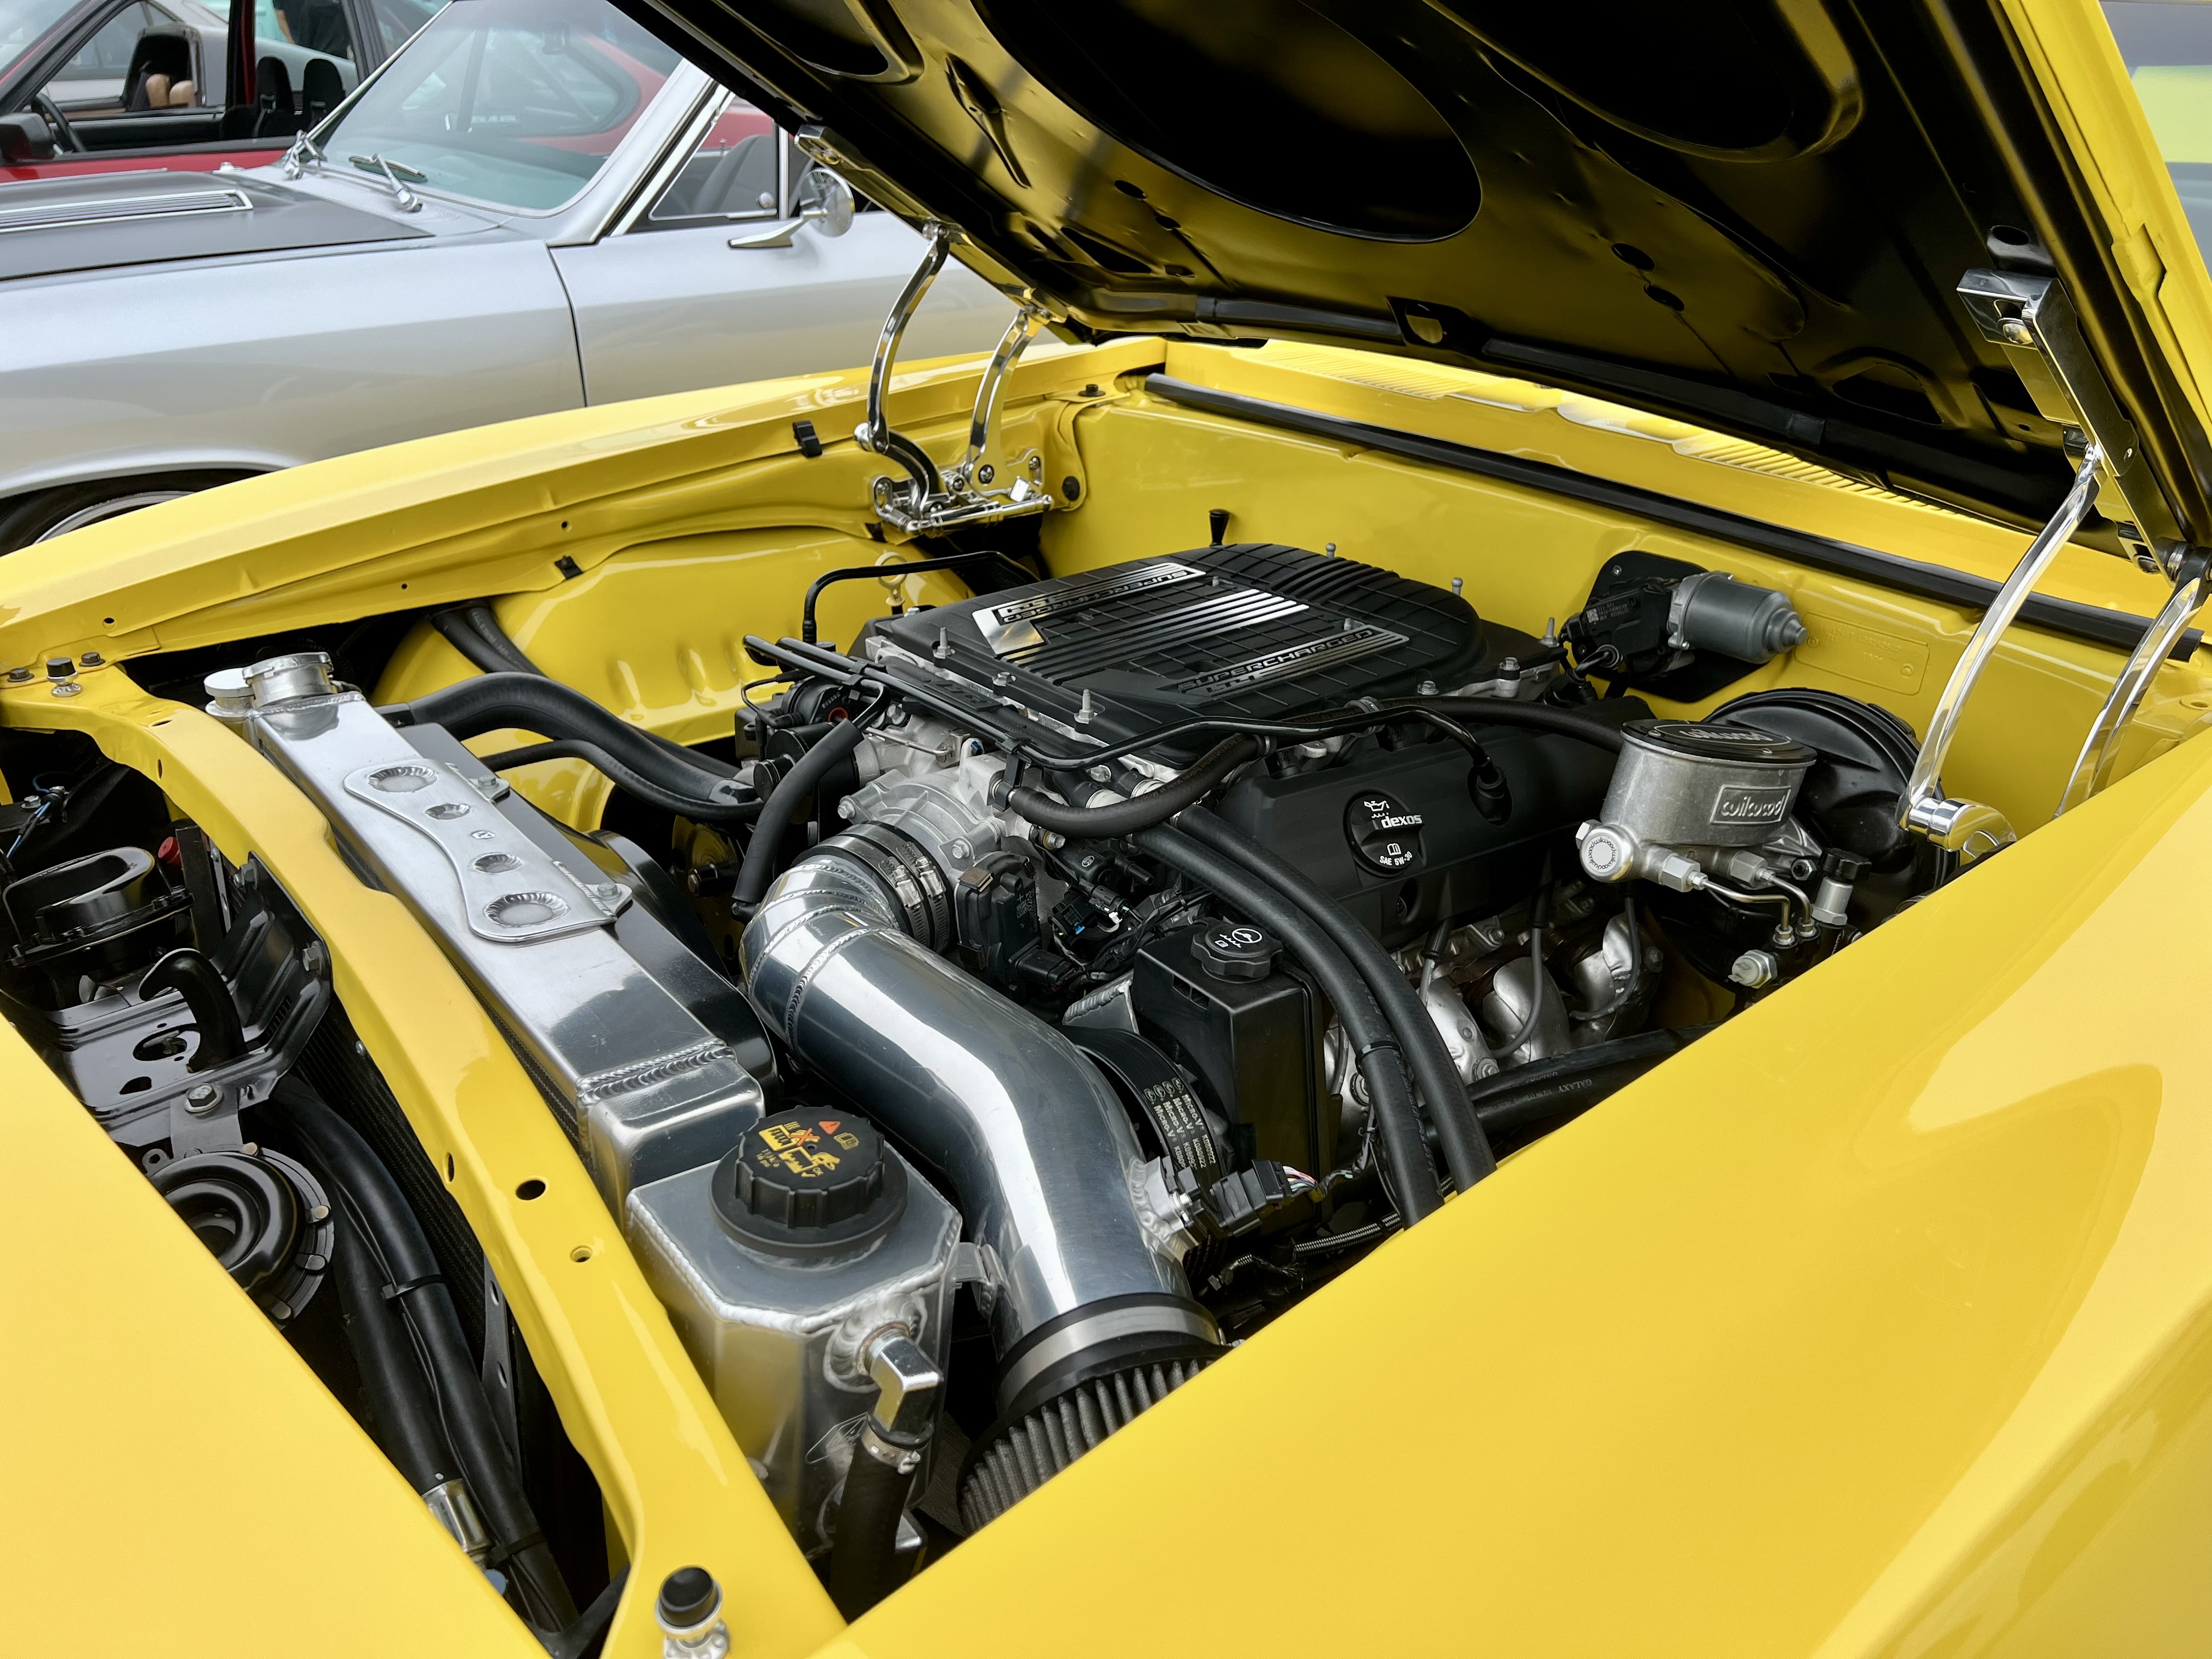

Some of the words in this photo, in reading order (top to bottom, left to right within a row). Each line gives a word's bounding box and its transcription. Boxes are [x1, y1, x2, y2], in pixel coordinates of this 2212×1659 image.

[1003, 570, 1188, 624] SUPERCHARGED
[1178, 630, 1373, 694] SUPERCHARGED
[1721, 795, 1785, 816] wilwood
[1381, 815, 1422, 828] dexos
[1379, 855, 1392, 866] SAE
[1394, 851, 1413, 866] 5W-30
[1558, 1078, 1593, 1093] GALAXY
